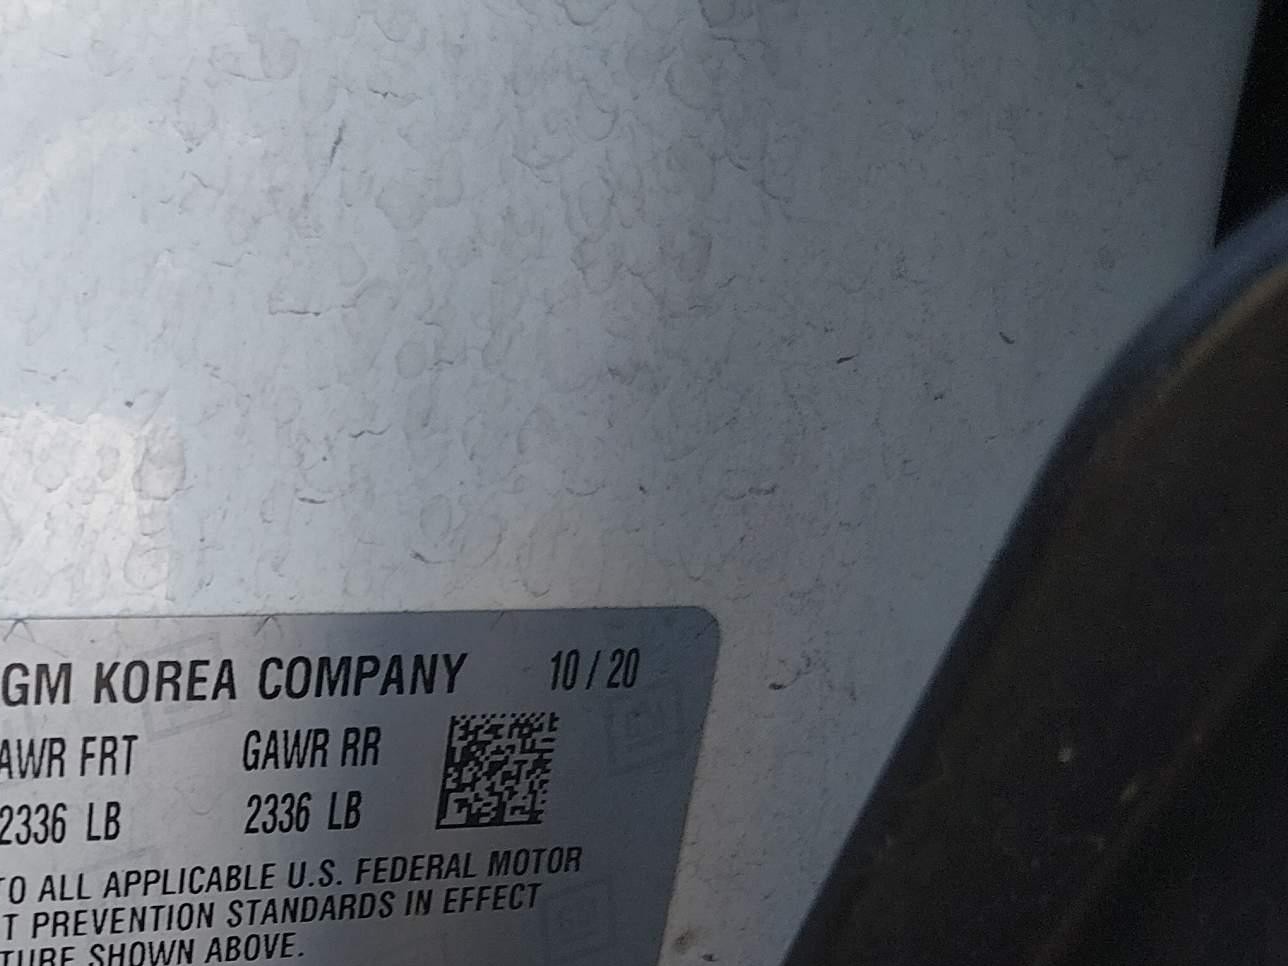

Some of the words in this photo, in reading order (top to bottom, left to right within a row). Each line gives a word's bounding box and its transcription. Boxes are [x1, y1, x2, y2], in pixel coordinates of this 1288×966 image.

[2, 663, 72, 706] GM
[94, 659, 236, 703] KOREA
[259, 653, 468, 699] COMPANY
[551, 649, 580, 690] 10
[607, 648, 640, 688] 20
[80, 735, 138, 776] FRT
[243, 728, 329, 771] GAWR
[341, 726, 381, 766] RR
[87, 802, 120, 841] LB
[245, 792, 312, 833] 2336
[328, 791, 362, 829] LB
[38, 873, 91, 902] ALL
[104, 863, 276, 898] APPLICABLE
[288, 859, 342, 889] U.S.
[356, 853, 476, 884] FEDERAL
[488, 847, 582, 876] MOTOR
[32, 902, 214, 938] PREVENTION
[227, 891, 396, 927] STANDARDS
[405, 890, 432, 915] IN
[443, 883, 542, 913] EFFECT
[205, 933, 304, 963] ABOVE.
